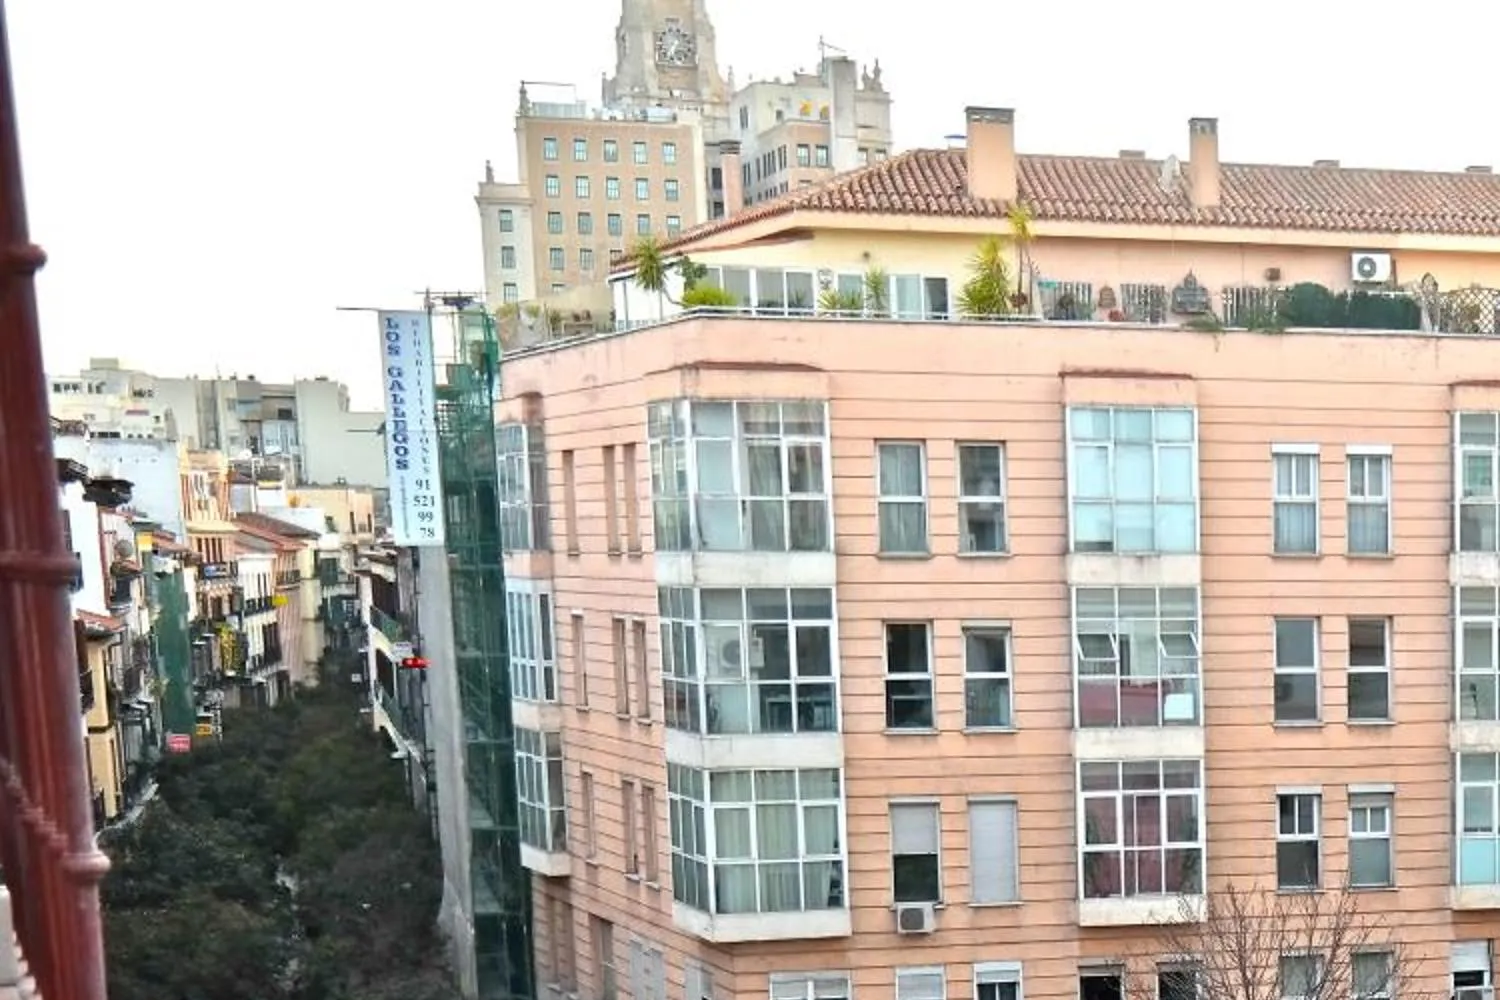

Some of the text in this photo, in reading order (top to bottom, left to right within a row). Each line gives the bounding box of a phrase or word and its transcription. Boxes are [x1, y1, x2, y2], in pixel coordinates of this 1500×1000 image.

[386, 318, 401, 356] LOS
[388, 366, 409, 470] GALLEGOS
[415, 479, 430, 491] 91
